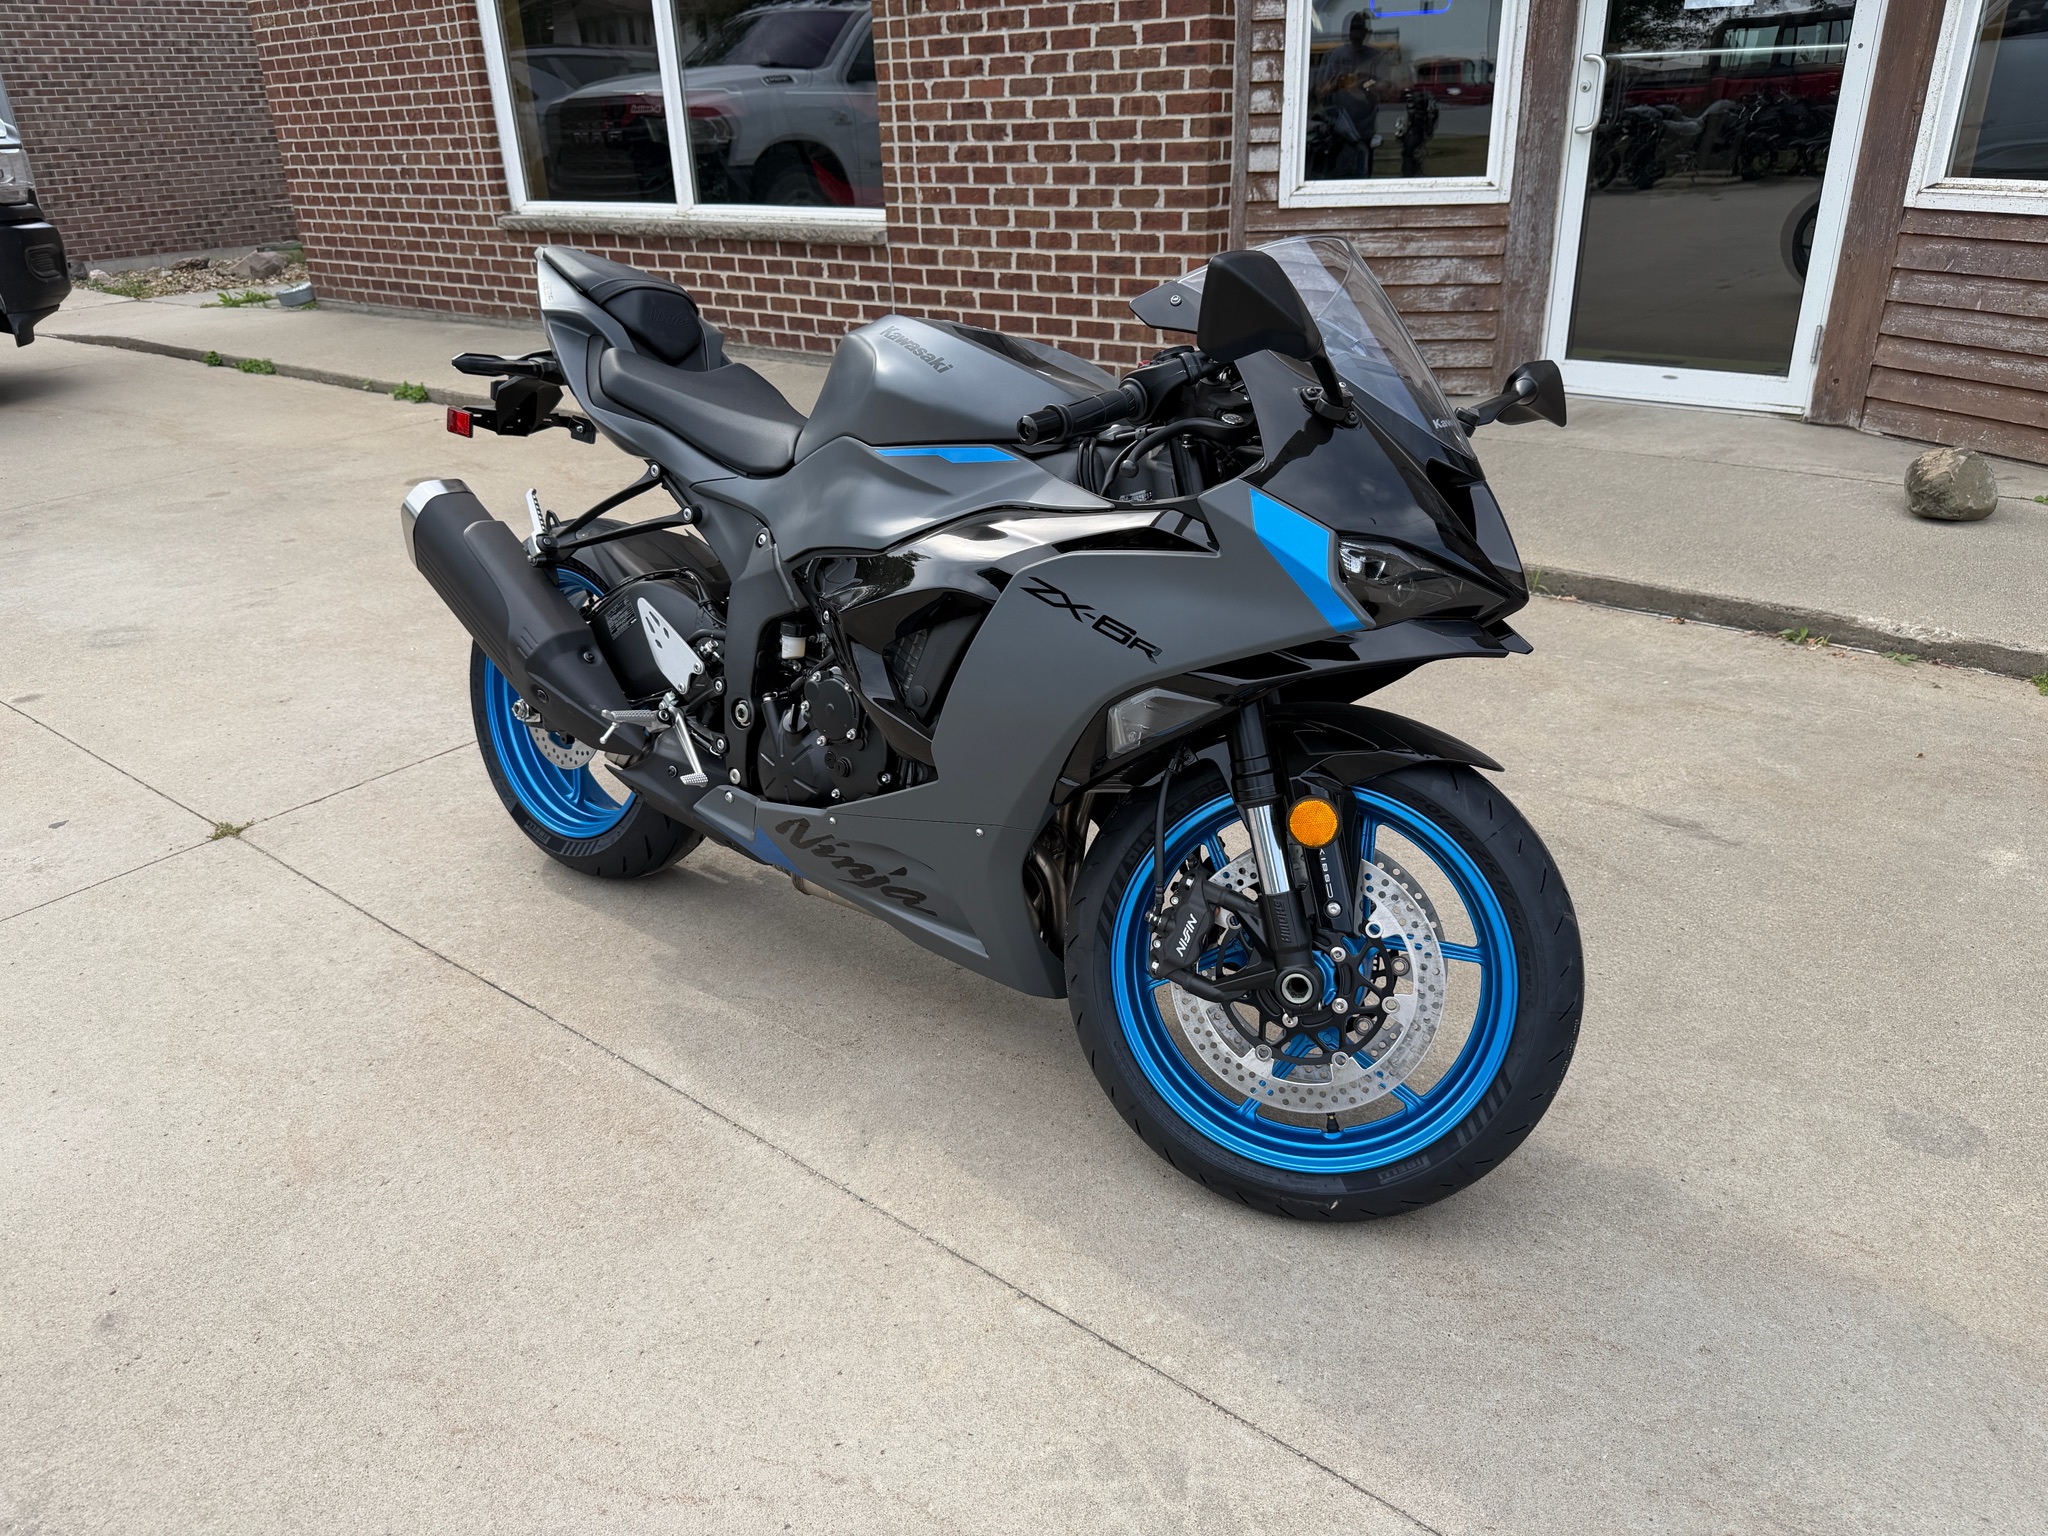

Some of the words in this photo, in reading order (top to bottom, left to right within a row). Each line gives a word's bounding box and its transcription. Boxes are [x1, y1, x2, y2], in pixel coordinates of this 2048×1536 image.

[879, 325, 954, 374] Kawasaki
[1019, 576, 1163, 665] ZX-6R
[523, 819, 551, 845] PIRELLI
[774, 817, 938, 917] Ninja
